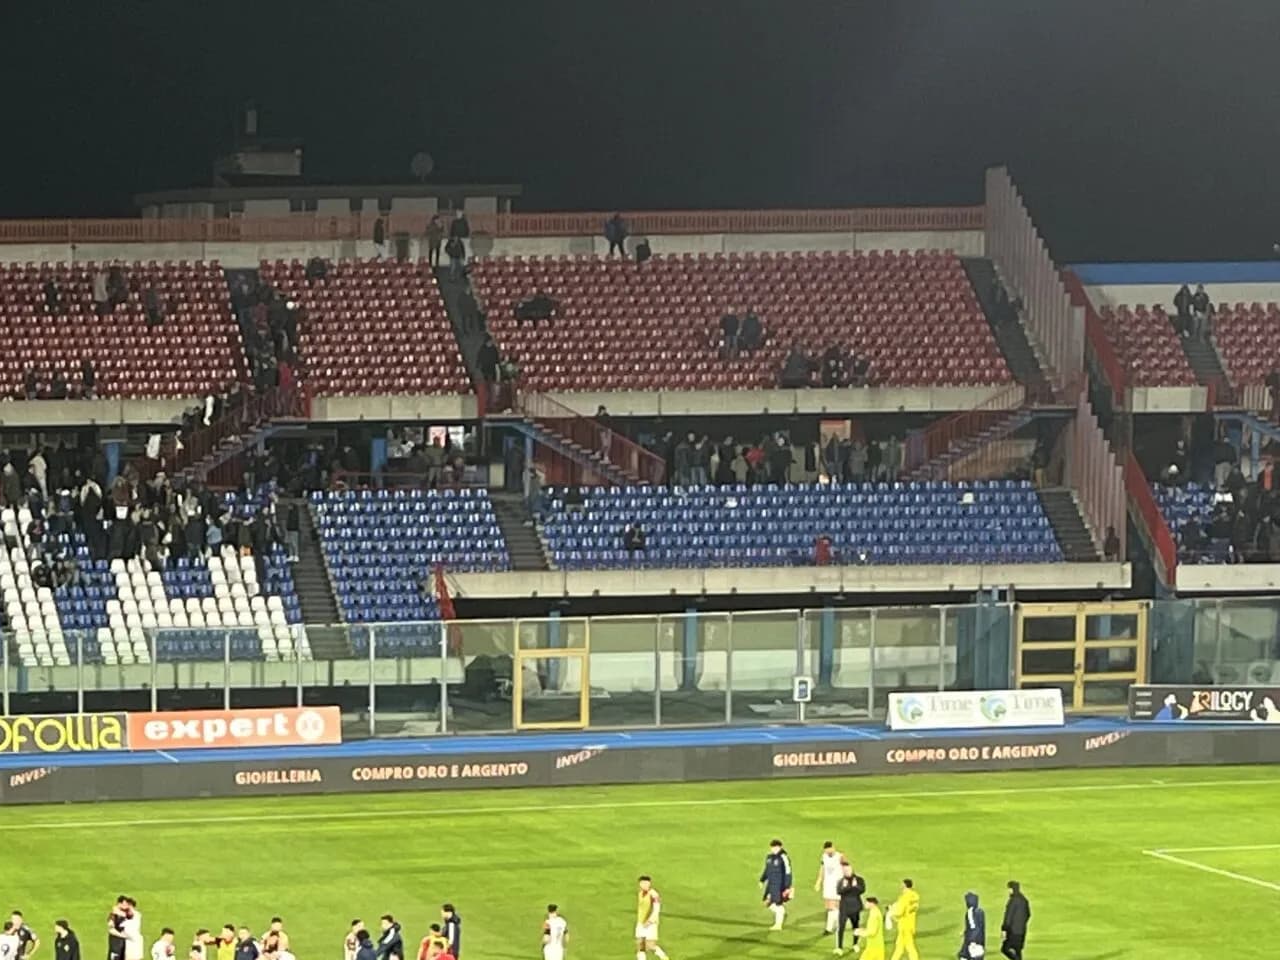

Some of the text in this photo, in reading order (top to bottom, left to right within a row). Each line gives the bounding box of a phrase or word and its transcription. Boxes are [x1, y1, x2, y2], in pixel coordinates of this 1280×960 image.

[1190, 690, 1253, 713] TRILOGY
[144, 712, 289, 745] expert
[773, 750, 857, 767] GIOIELLERIA
[886, 743, 1058, 763] COMPRO ORO E ARGENTO
[235, 768, 322, 785] GIOIELLERIA
[351, 762, 529, 781] COMPRO ORO E ARGENTO
[1, 943, 10, 956] 9
